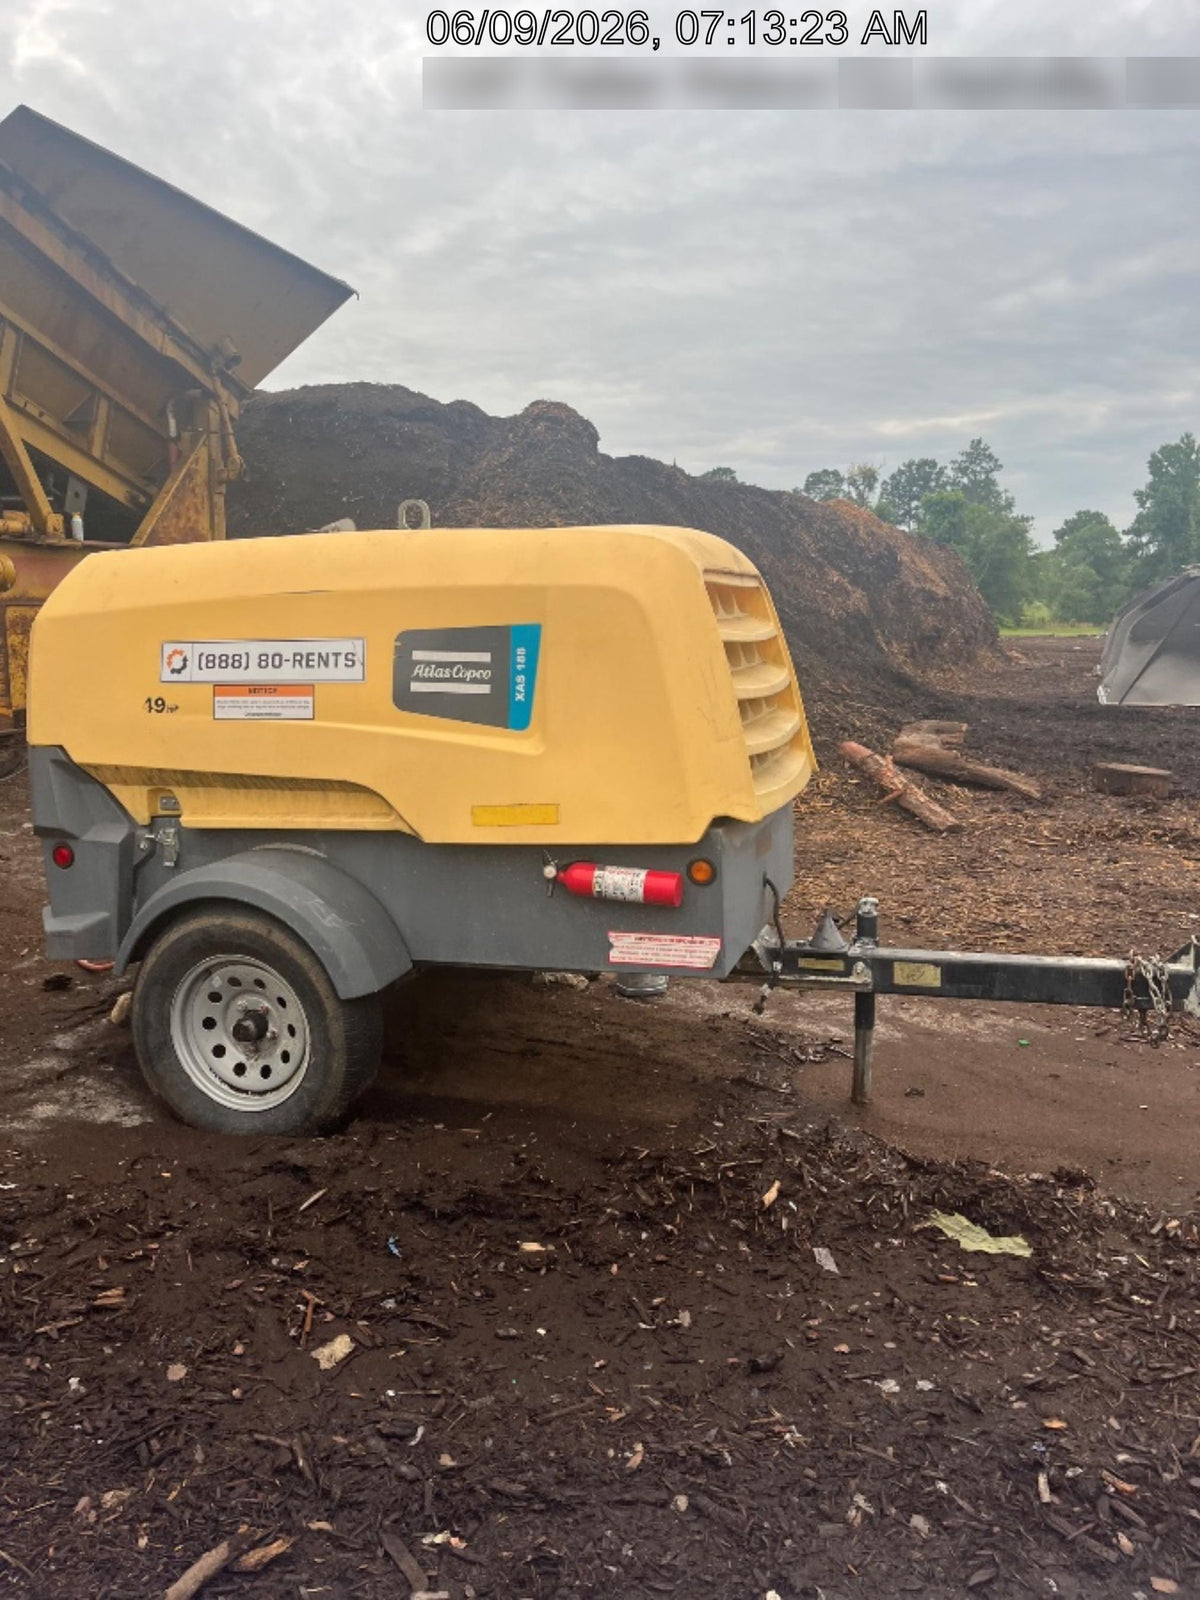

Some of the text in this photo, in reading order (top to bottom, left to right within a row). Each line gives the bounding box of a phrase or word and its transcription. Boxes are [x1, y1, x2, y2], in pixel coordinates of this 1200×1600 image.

[198, 651, 357, 671] (888) 80-RENTS
[515, 675, 526, 702] XAS
